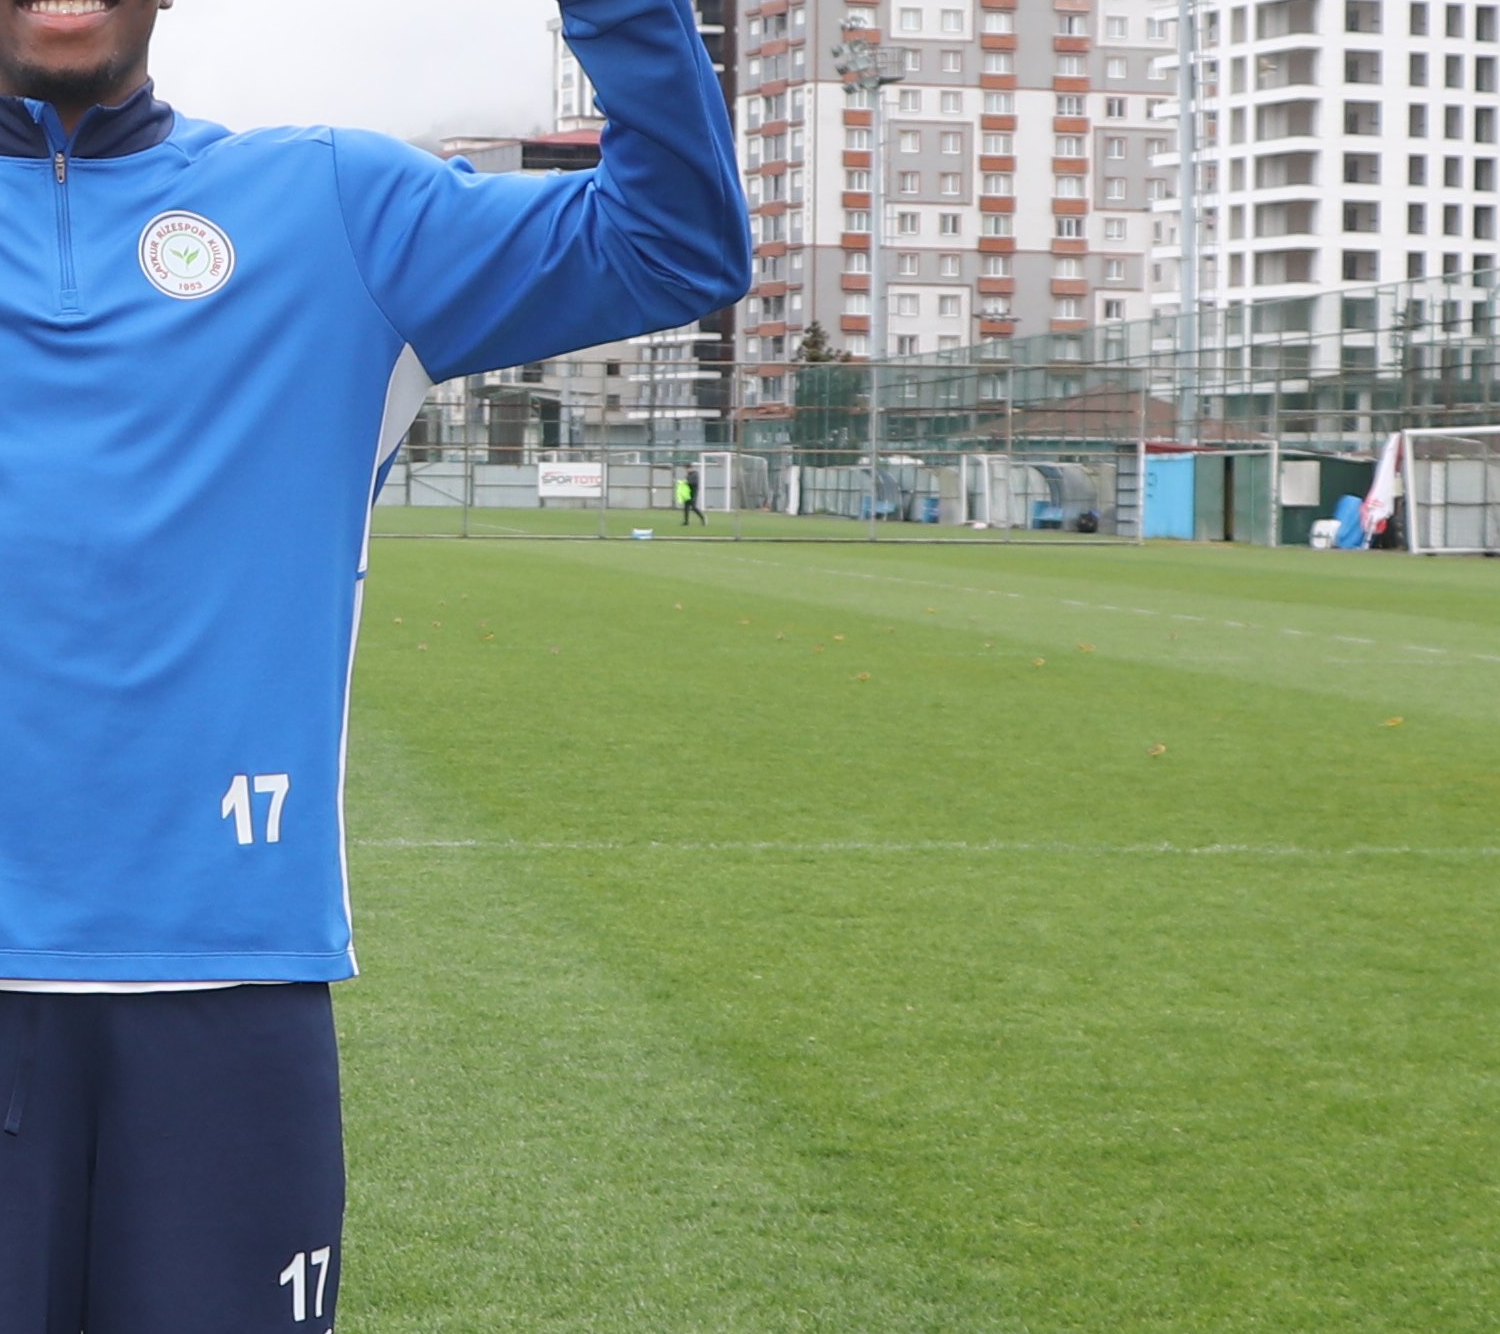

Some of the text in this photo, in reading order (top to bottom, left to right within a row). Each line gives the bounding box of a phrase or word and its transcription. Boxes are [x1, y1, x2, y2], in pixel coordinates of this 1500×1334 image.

[178, 281, 203, 291] 1953
[221, 773, 290, 845] 17
[279, 1246, 331, 1322] 17
